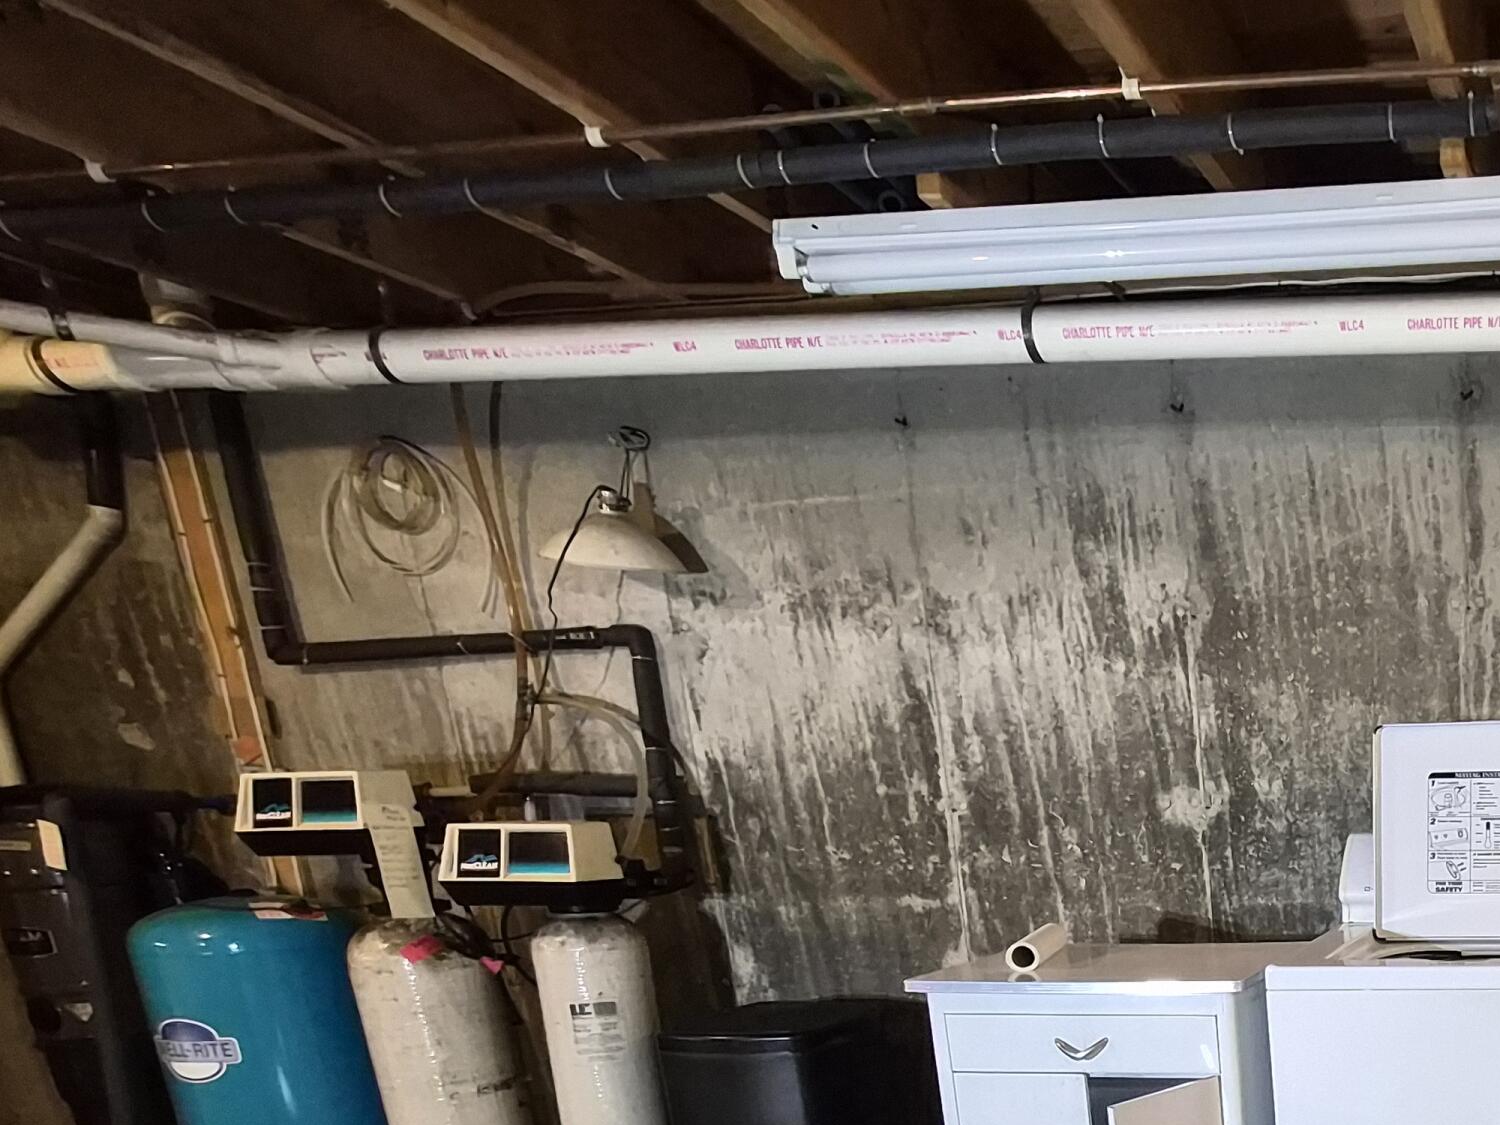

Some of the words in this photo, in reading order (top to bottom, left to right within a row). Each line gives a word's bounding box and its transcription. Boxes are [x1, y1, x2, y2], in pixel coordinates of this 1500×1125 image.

[1339, 319, 1365, 332] WLC4
[1407, 316, 1459, 330] CHARLOTTE
[1463, 316, 1483, 329] PIPE
[1062, 326, 1112, 340] CHARLOTTE
[1115, 325, 1135, 338] PIPE
[734, 337, 783, 350] CHARLOTTE
[785, 336, 804, 349] PIPE
[1430, 852, 1436, 860] 3
[158, 1041, 234, 1058] ELL-RITE
